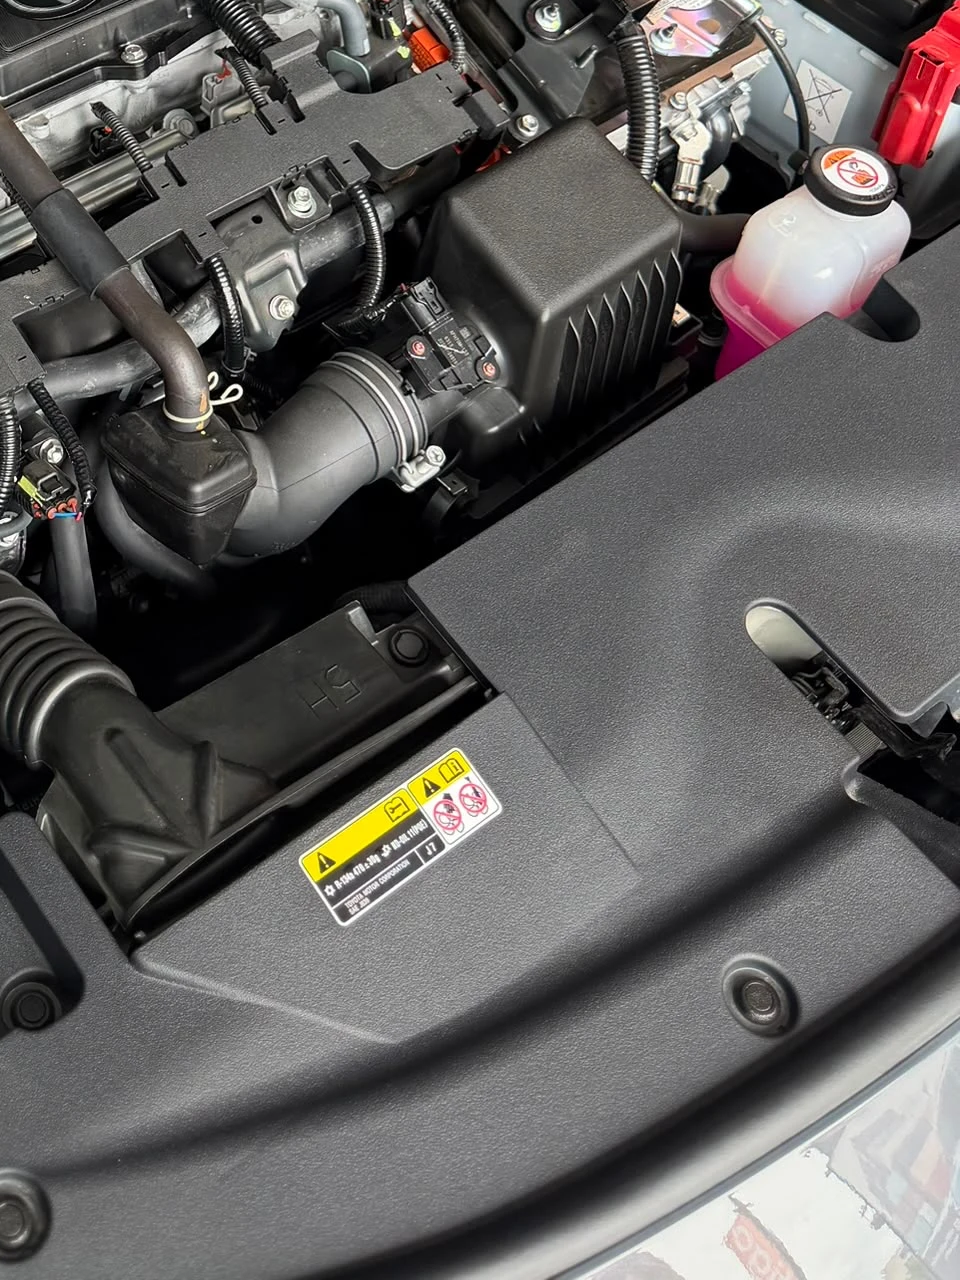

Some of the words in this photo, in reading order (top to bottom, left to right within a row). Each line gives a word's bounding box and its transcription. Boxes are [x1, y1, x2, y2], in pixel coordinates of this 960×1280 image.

[425, 842, 437, 856] J7
[335, 873, 355, 890] R-134a
[344, 893, 364, 909] TOYOTA
[362, 881, 380, 896] MOTOR
[379, 858, 410, 884] CORPORATION
